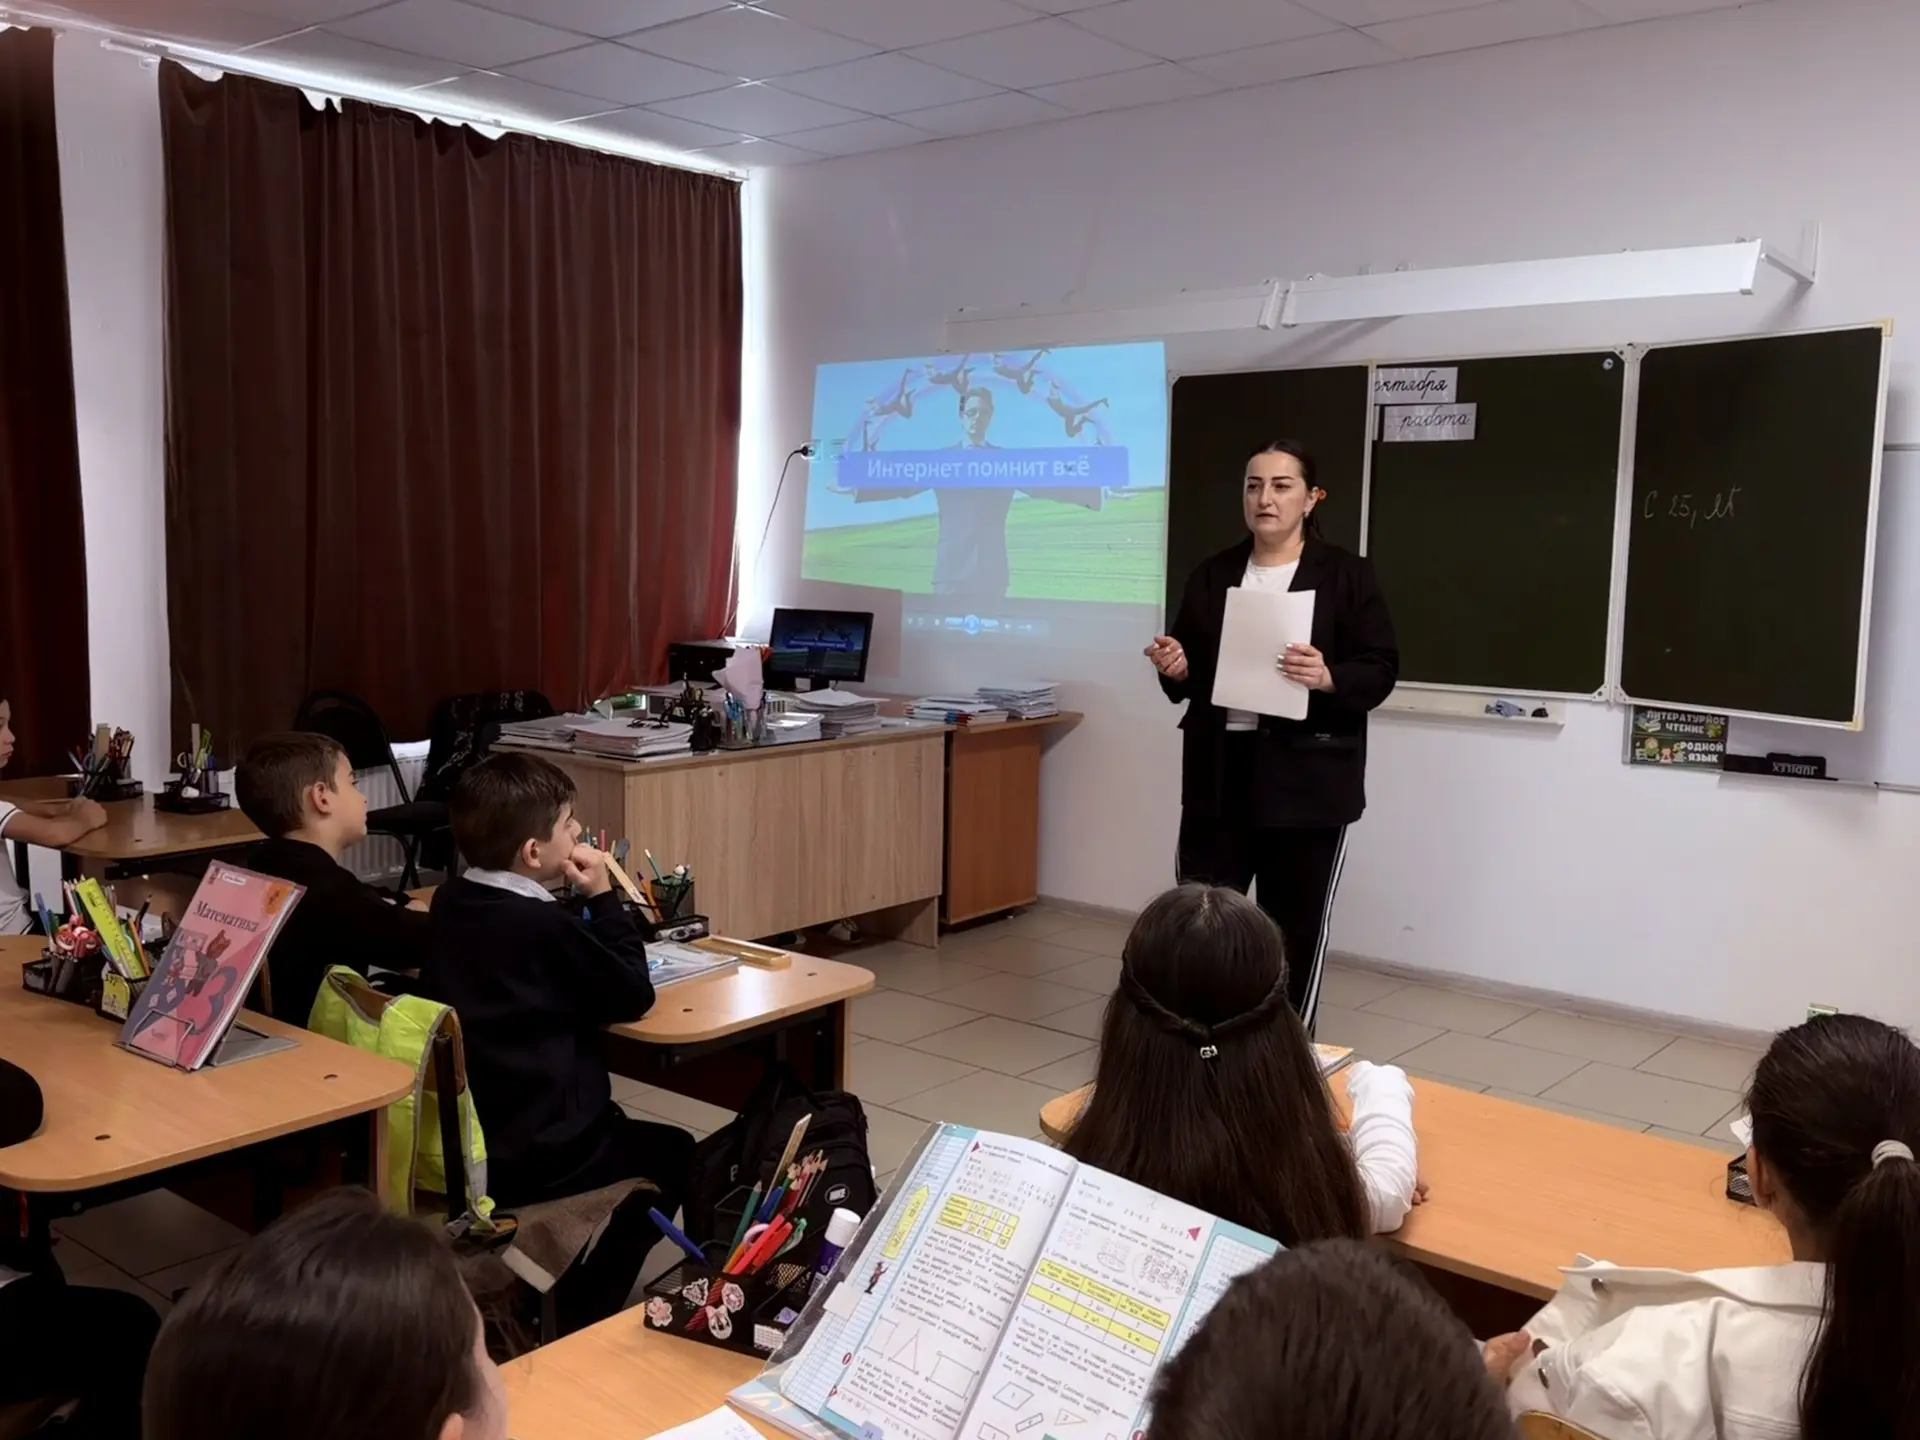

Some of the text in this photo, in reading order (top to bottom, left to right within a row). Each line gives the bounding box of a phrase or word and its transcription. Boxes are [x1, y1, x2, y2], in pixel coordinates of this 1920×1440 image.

[1399, 404, 1469, 433] работа
[868, 454, 1091, 482] Интернет помнит всё
[1646, 709, 1726, 726] ЛИТЕРАТУРНОЕ
[1665, 721, 1705, 734] ЧТЕНИЕ
[1680, 740, 1725, 753] РОДНОЙ
[1687, 750, 1719, 764] ЯЗЫК
[193, 900, 260, 933] Математика
